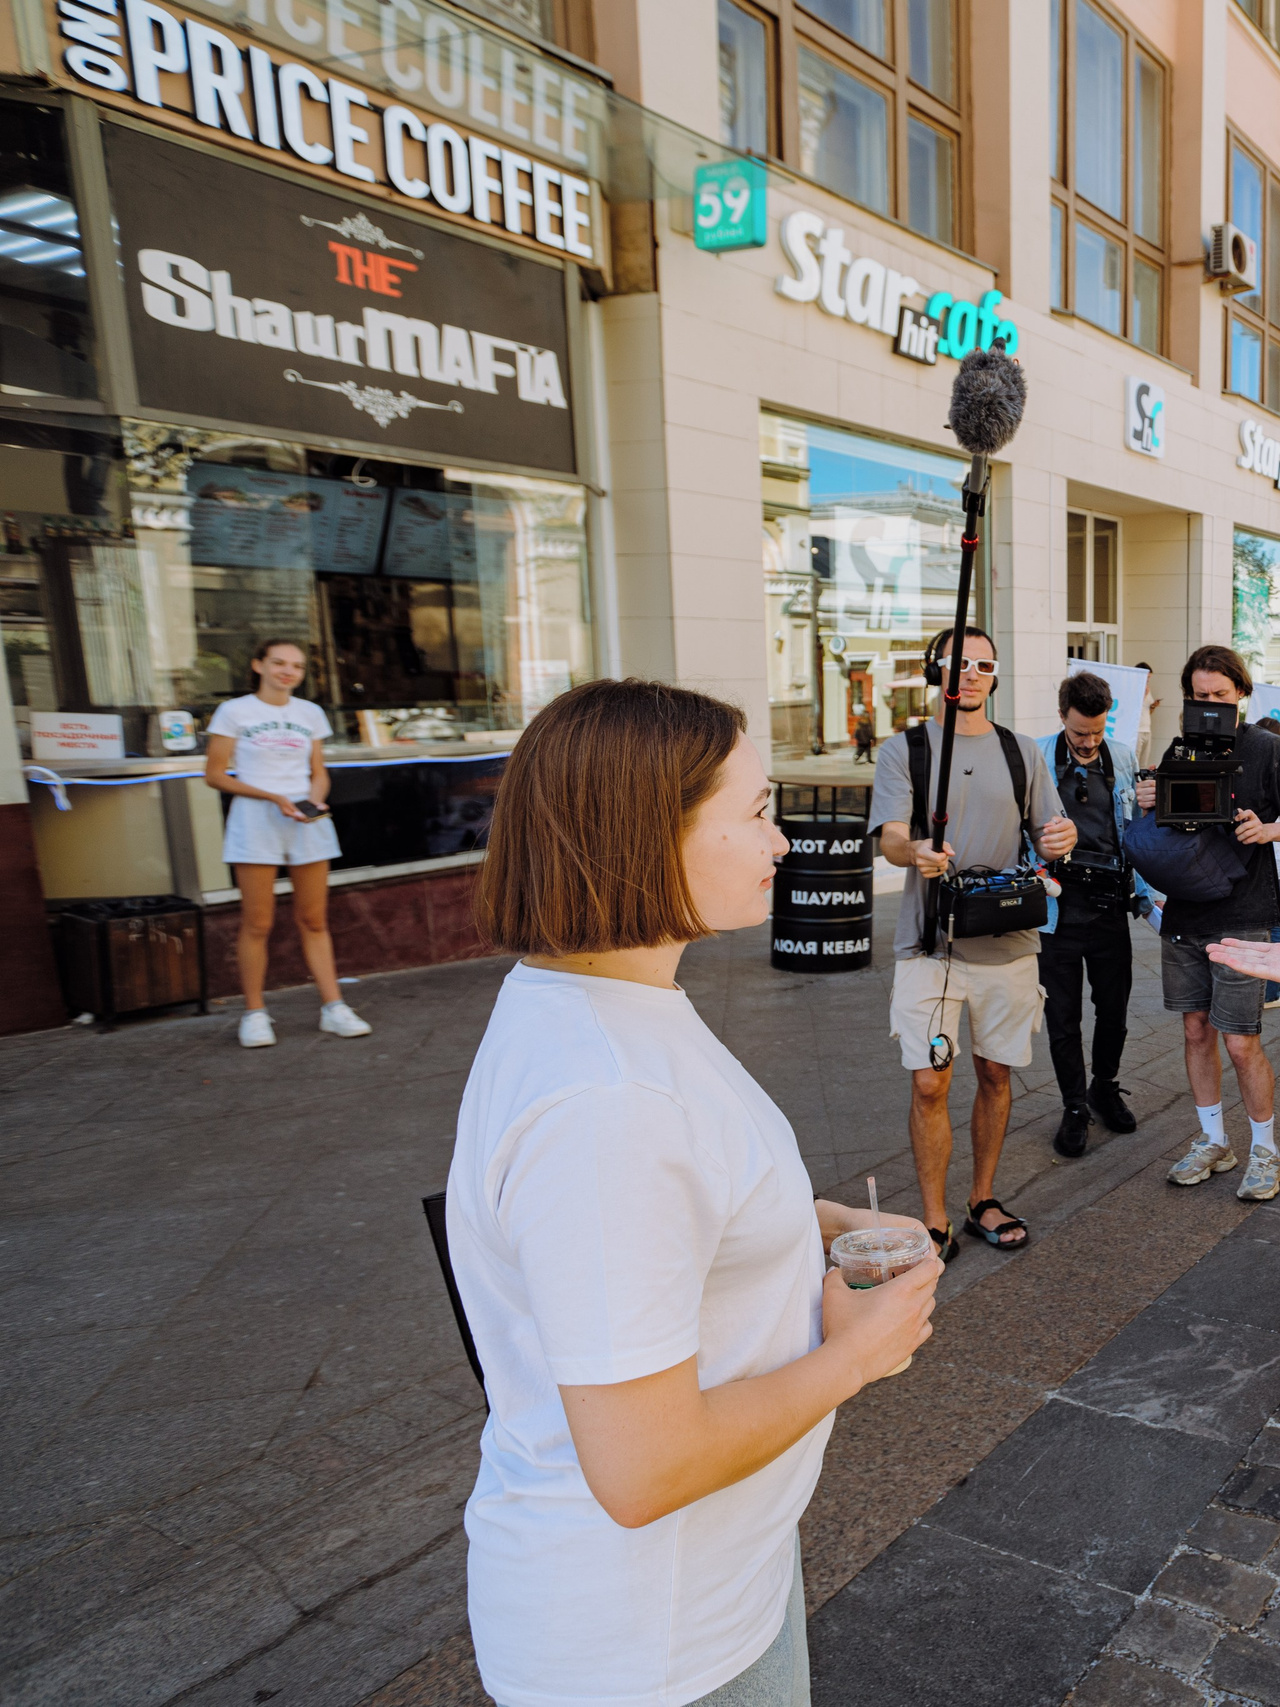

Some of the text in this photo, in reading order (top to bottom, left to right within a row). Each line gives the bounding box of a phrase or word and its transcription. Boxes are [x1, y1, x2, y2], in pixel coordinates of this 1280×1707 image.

[57, 0, 128, 91] ON
[122, 0, 377, 184] PRICE
[383, 105, 593, 259] COFFEE
[697, 176, 751, 228] 59
[328, 240, 418, 298] THE
[774, 210, 922, 337] Star
[899, 309, 938, 363] hit
[791, 839, 863, 854] ХОТ ДОГ
[791, 890, 866, 905] ШАУРМА
[822, 937, 871, 955] КЕБАБ
